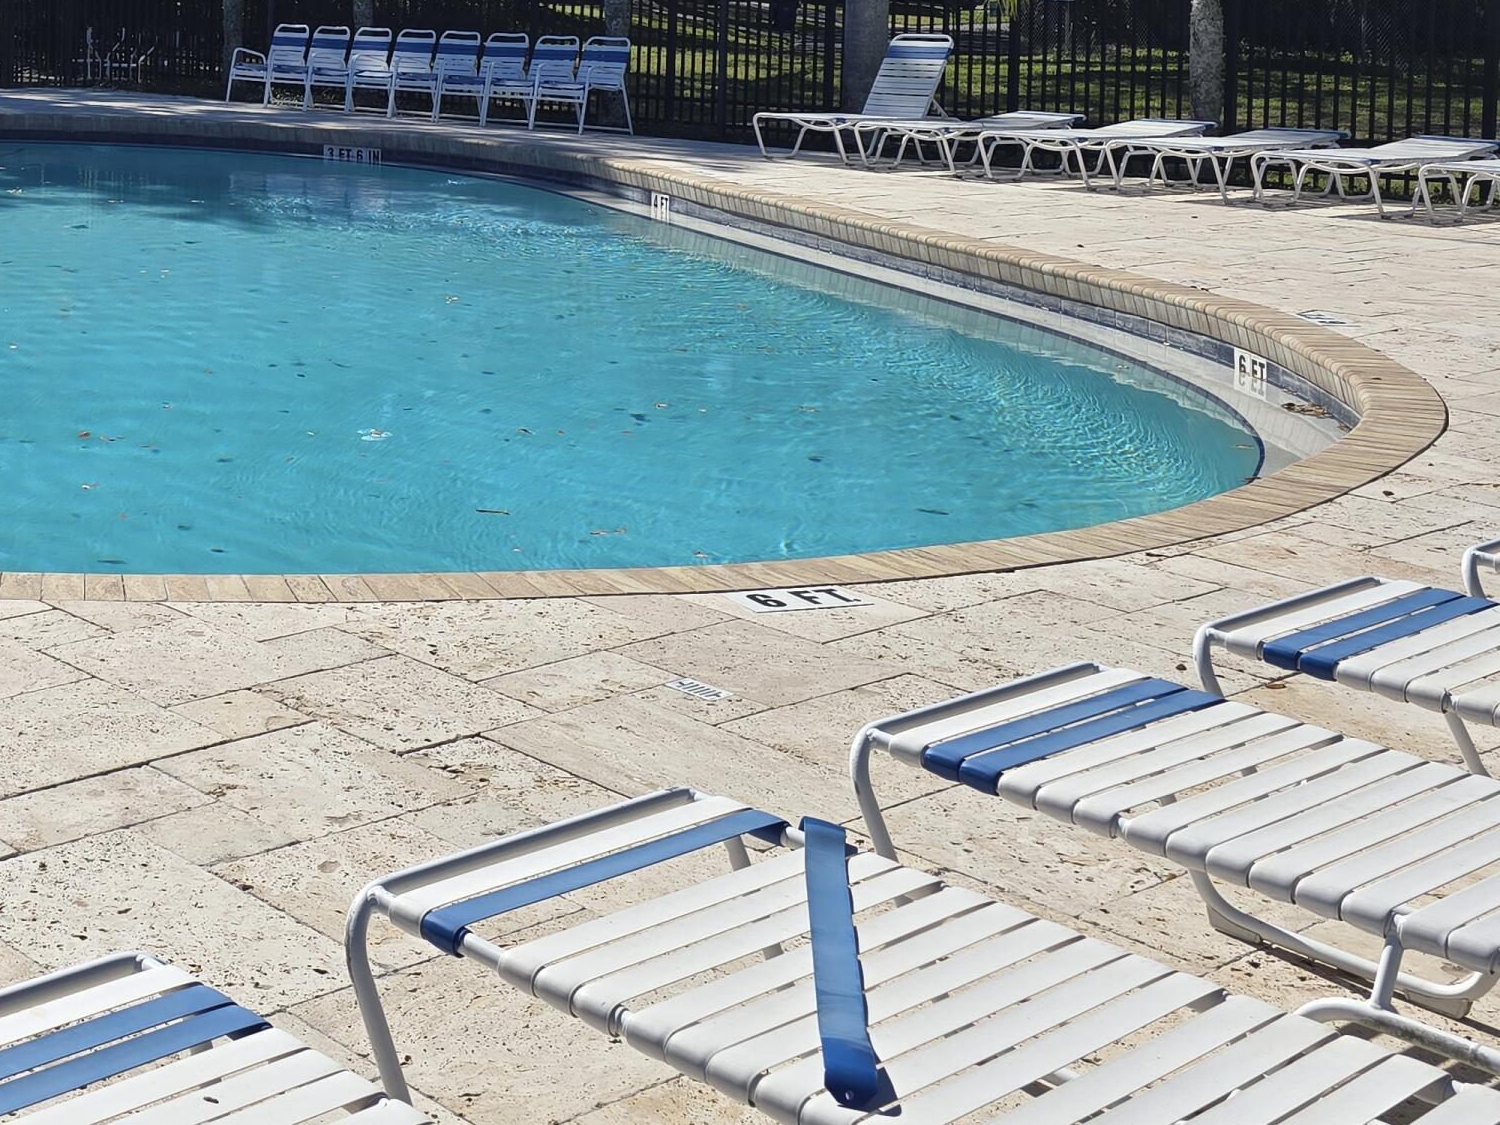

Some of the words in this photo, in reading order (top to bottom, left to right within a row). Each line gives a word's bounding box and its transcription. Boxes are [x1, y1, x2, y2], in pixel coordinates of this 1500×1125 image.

[327, 147, 334, 159] 3
[340, 147, 352, 161] FT
[356, 149, 363, 162] 6
[368, 150, 380, 164] IN
[653, 194, 658, 208] 4
[660, 196, 669, 211] FT
[1238, 354, 1246, 374] 6
[1251, 359, 1266, 381] FT
[746, 593, 787, 607] 6
